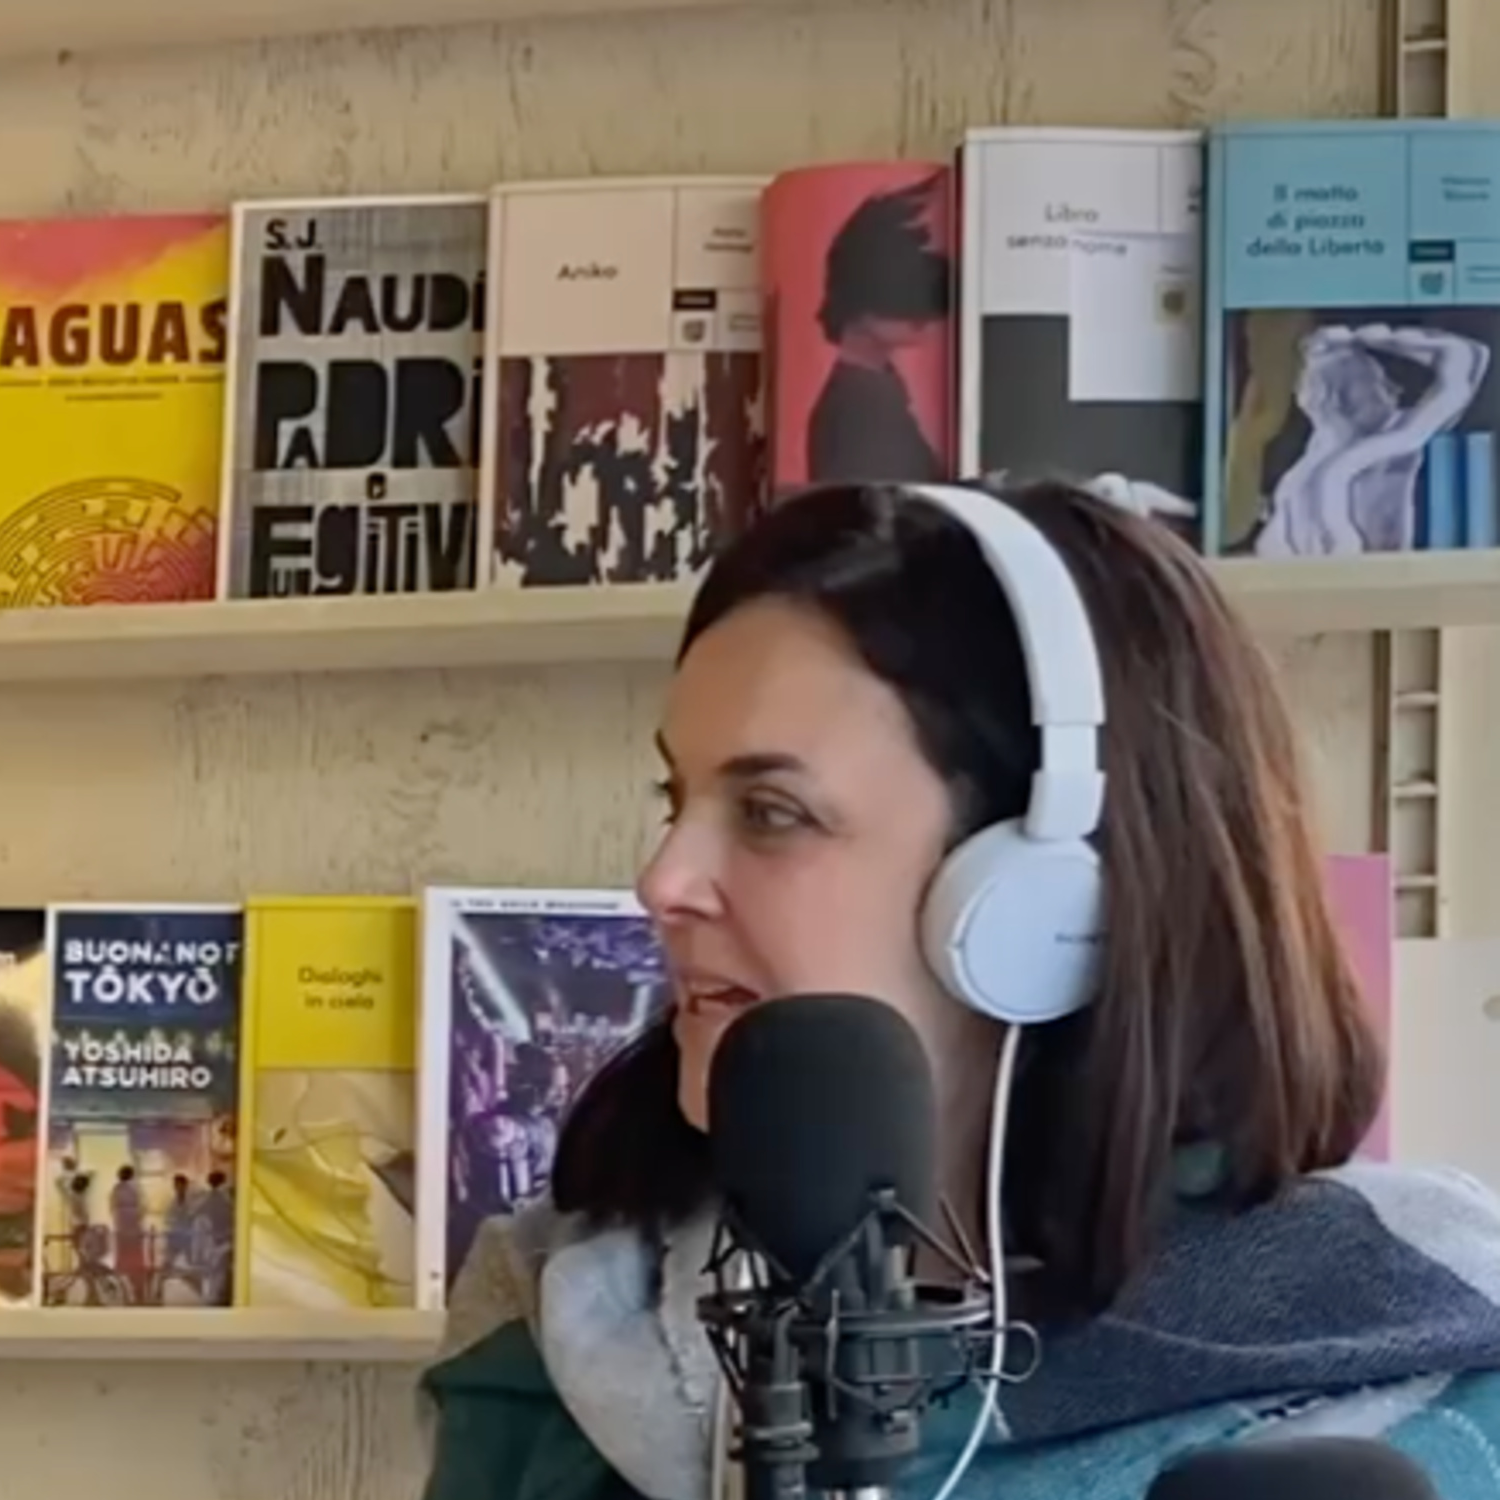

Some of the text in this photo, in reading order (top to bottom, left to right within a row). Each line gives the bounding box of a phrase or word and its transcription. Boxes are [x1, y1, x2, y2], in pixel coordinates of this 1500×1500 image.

[1044, 200, 1099, 222] Libro
[63, 1039, 193, 1064] YOSHIDA
[62, 1066, 212, 1089] ATSUHIRO
